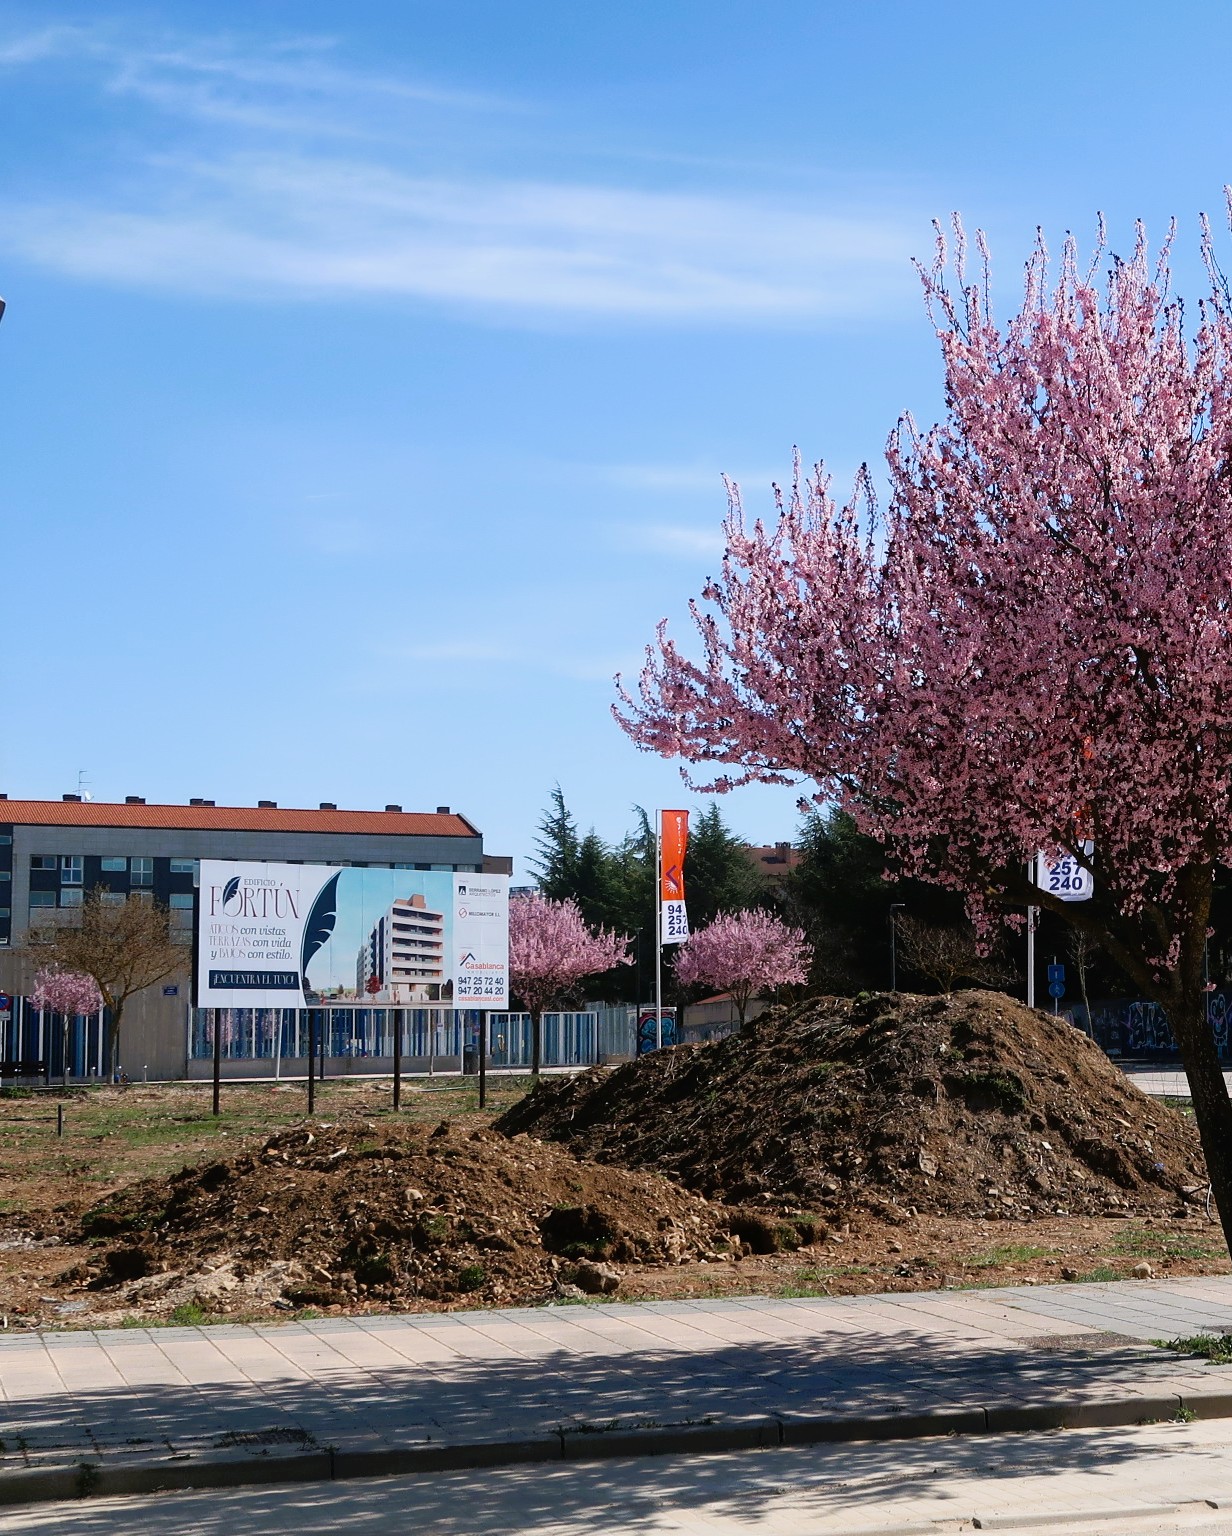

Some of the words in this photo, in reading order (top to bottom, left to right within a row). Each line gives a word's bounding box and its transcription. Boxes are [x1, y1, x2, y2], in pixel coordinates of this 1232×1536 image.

[244, 879, 276, 887] EDIFICIO
[1050, 877, 1083, 891] 240
[209, 882, 301, 920] FORTÚN
[240, 926, 257, 935] con
[259, 924, 286, 936] vistas
[668, 926, 688, 936] 240
[209, 935, 251, 947] TERRAZAS
[252, 939, 269, 947] con
[271, 936, 291, 948] vida
[210, 950, 217, 961] y
[219, 947, 246, 959] BAJOS
[247, 950, 264, 959] con
[266, 948, 293, 960] estilo.
[465, 961, 504, 970] Casablanca
[262, 974, 271, 985] EL
[458, 976, 471, 985] 947
[473, 976, 483, 985] 25
[484, 977, 493, 986] 72
[494, 977, 504, 986] 40
[458, 986, 471, 995] 947
[473, 986, 483, 995] 20
[484, 986, 493, 995] 44
[494, 986, 504, 996] 20
